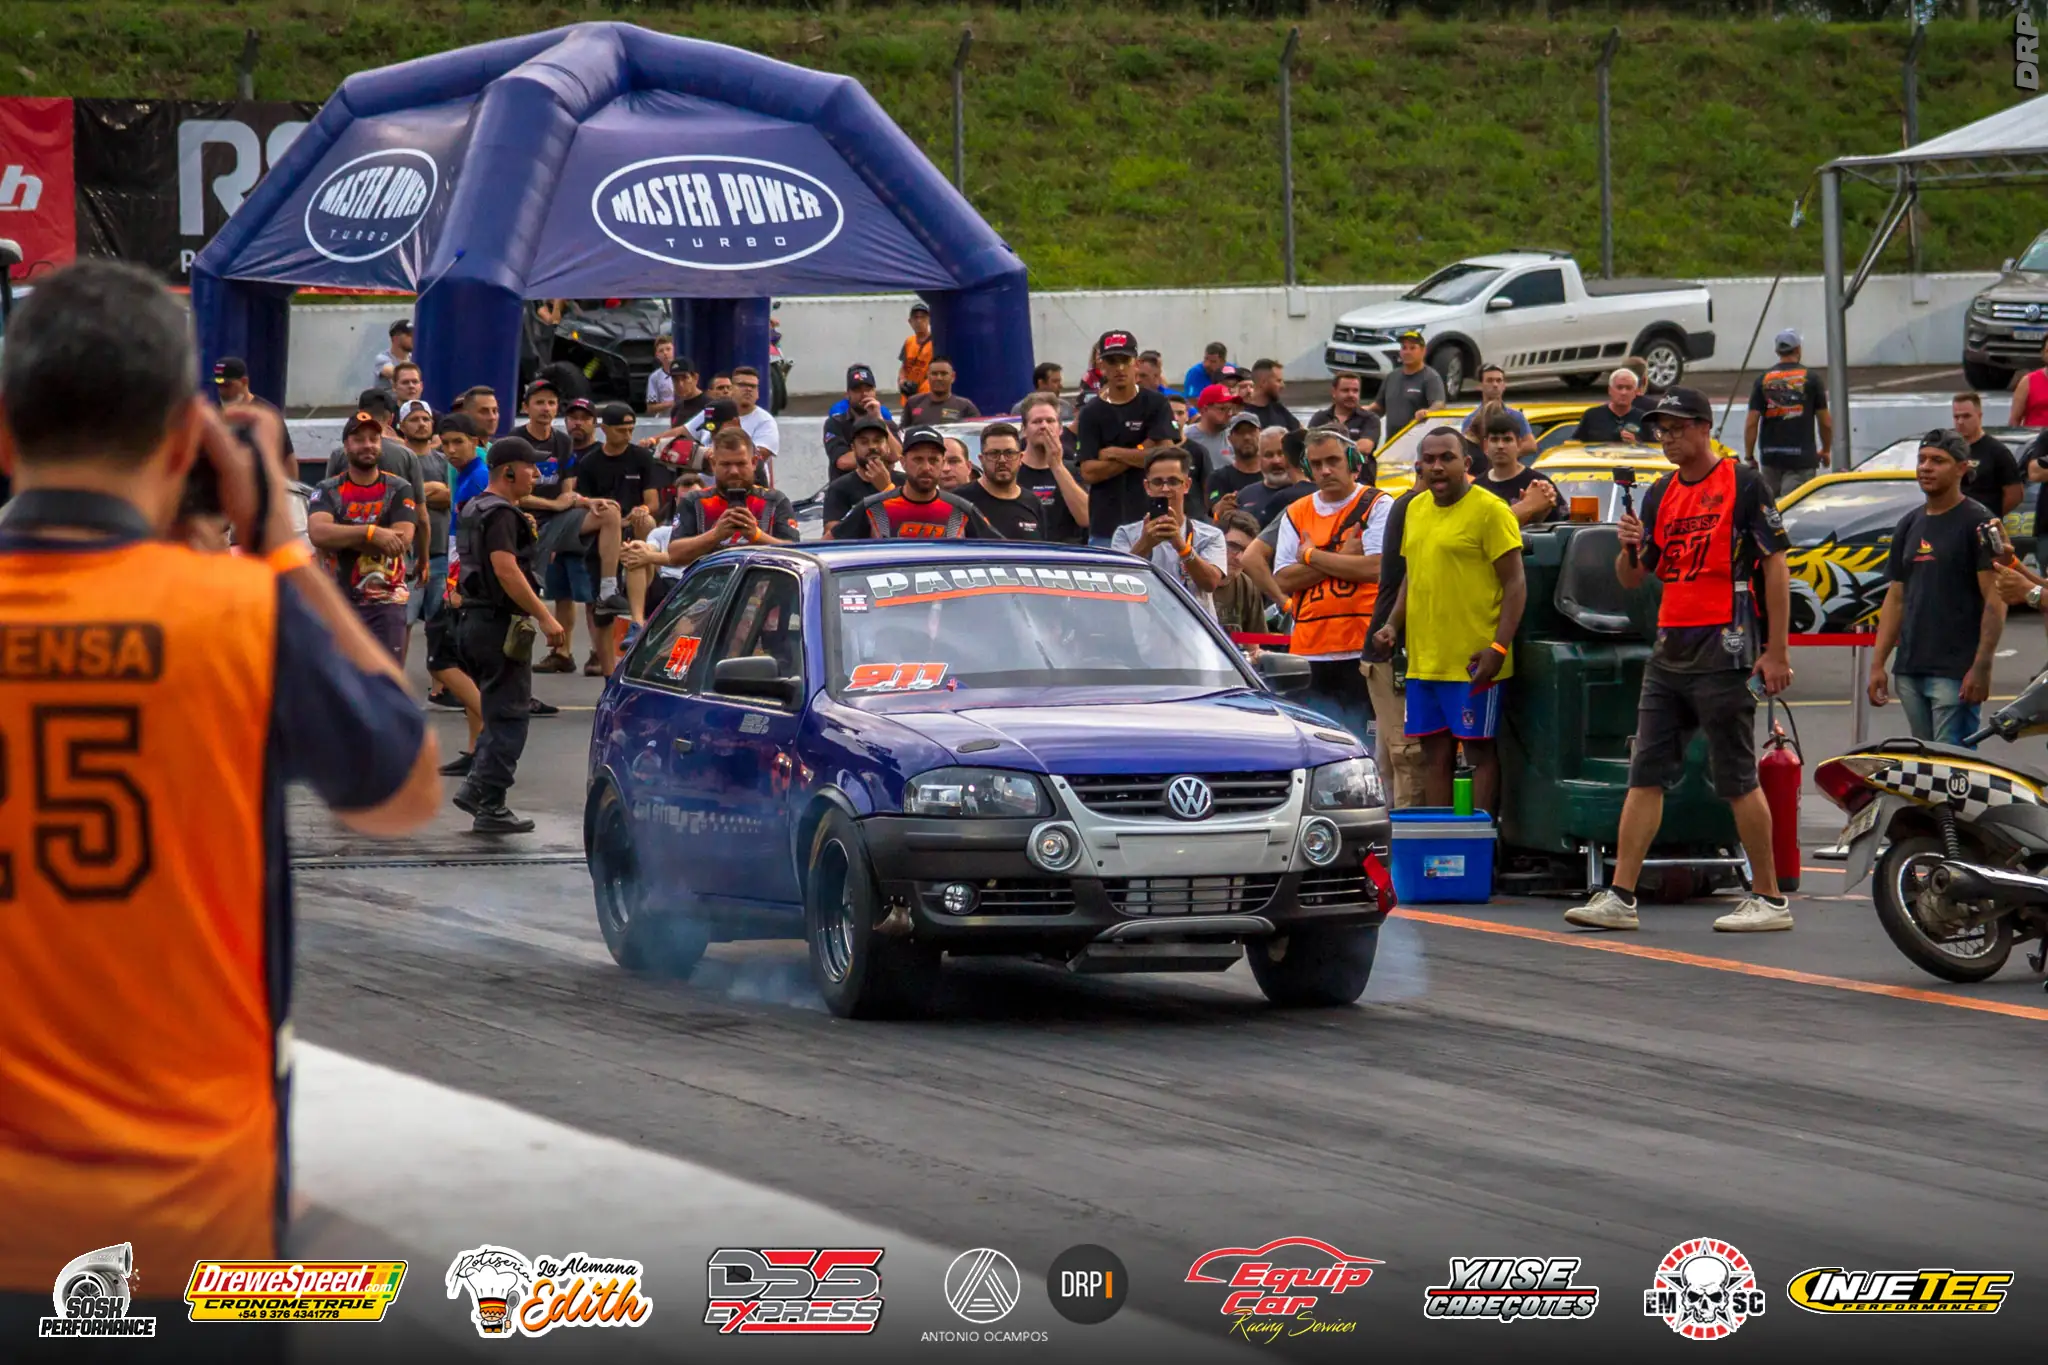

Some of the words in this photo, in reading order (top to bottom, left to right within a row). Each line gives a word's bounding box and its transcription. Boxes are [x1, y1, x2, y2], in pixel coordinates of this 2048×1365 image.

[319, 166, 394, 219] MASTER
[611, 173, 721, 226] MASTER
[718, 173, 822, 226] POWER
[330, 229, 389, 241] TURBO
[666, 237, 787, 248] TURBO
[867, 567, 1148, 599] PAULINHO
[844, 663, 948, 692] 911
[0, 704, 153, 903] 5
